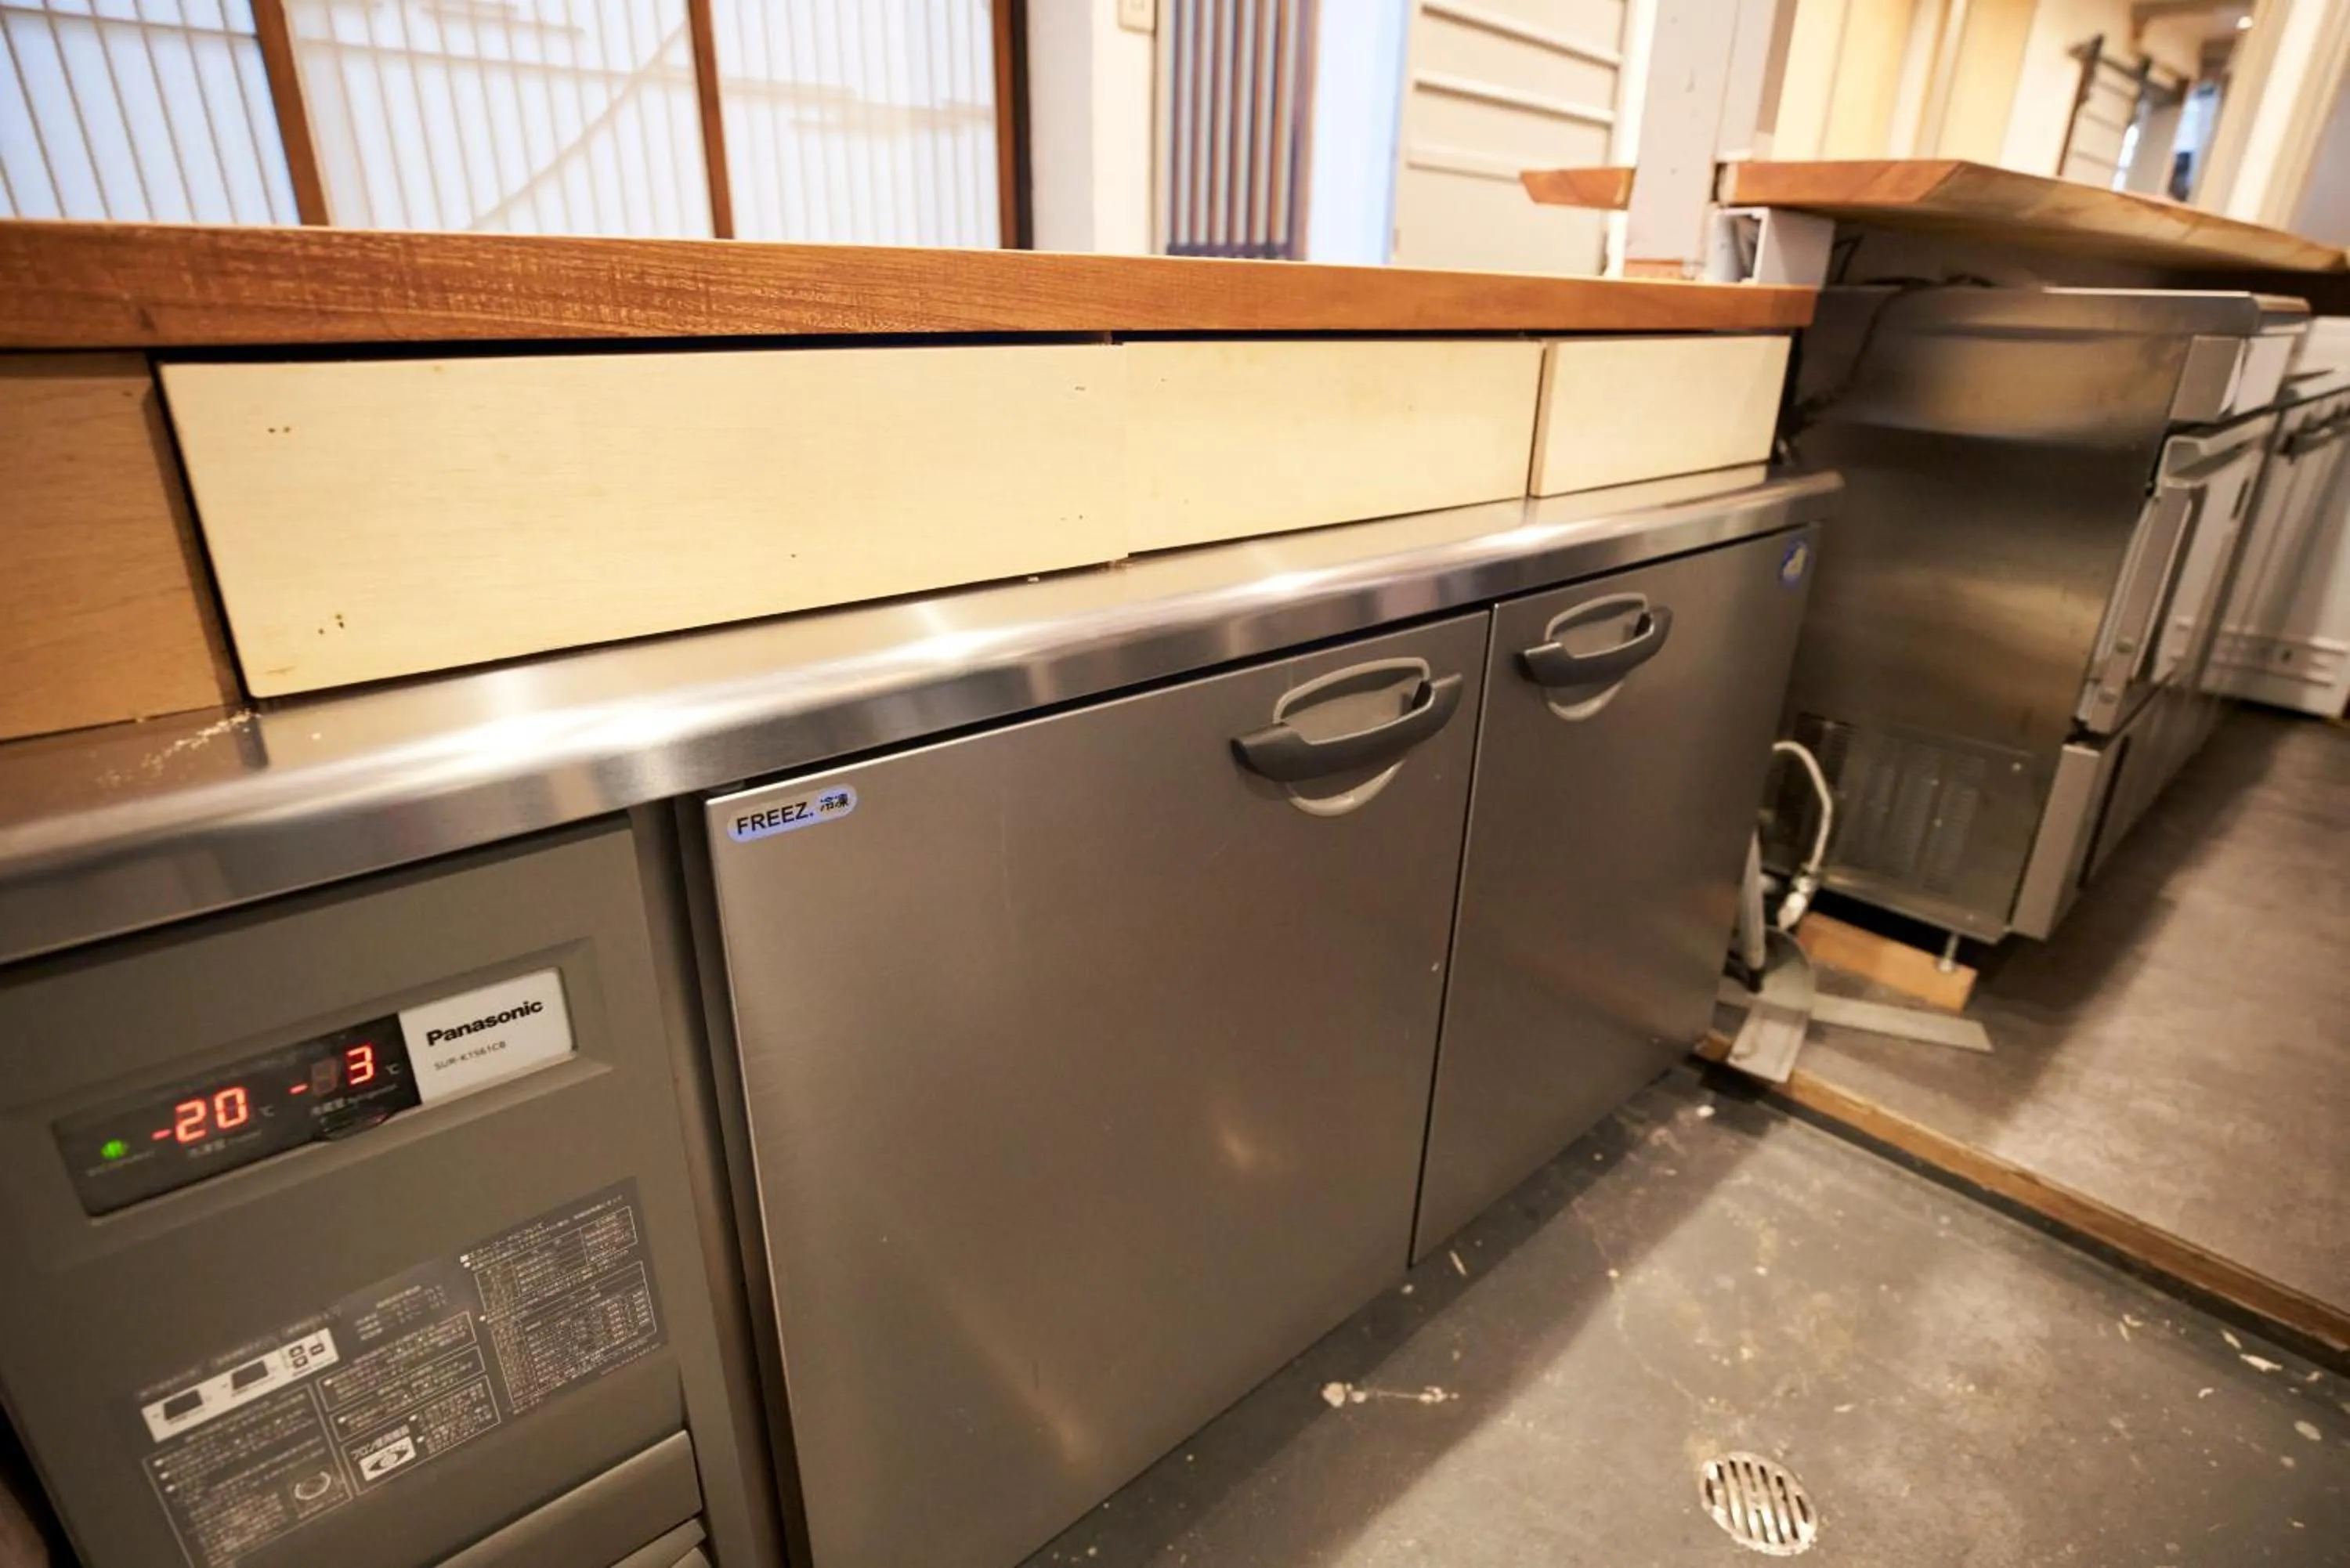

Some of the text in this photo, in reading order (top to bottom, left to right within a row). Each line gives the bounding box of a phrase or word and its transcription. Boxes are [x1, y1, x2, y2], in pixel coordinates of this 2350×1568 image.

[736, 802, 814, 835] FREEZ.
[819, 793, 849, 812] 冷凍
[425, 1001, 544, 1046] Panasonic
[151, 1087, 248, 1144] -20
